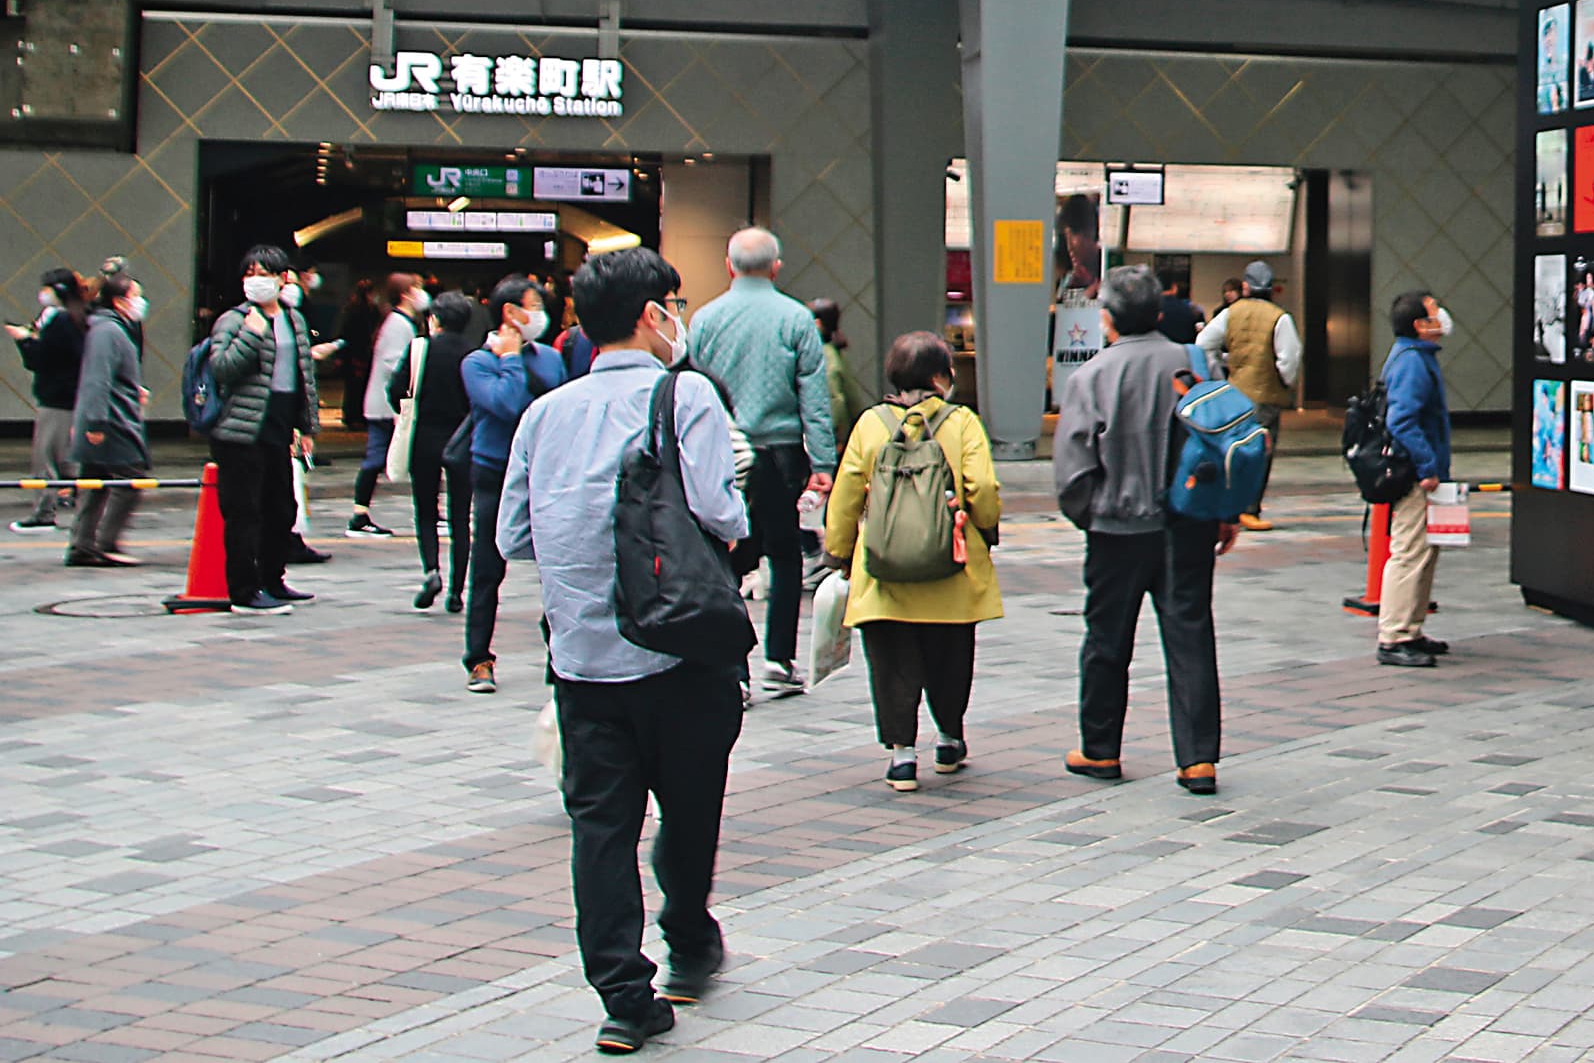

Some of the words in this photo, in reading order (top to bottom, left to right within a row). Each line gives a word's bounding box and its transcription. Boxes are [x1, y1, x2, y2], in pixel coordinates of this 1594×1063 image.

[369, 51, 443, 93] JR
[451, 53, 624, 100] 有楽町駅
[553, 96, 624, 118] Station
[427, 167, 461, 187] JR
